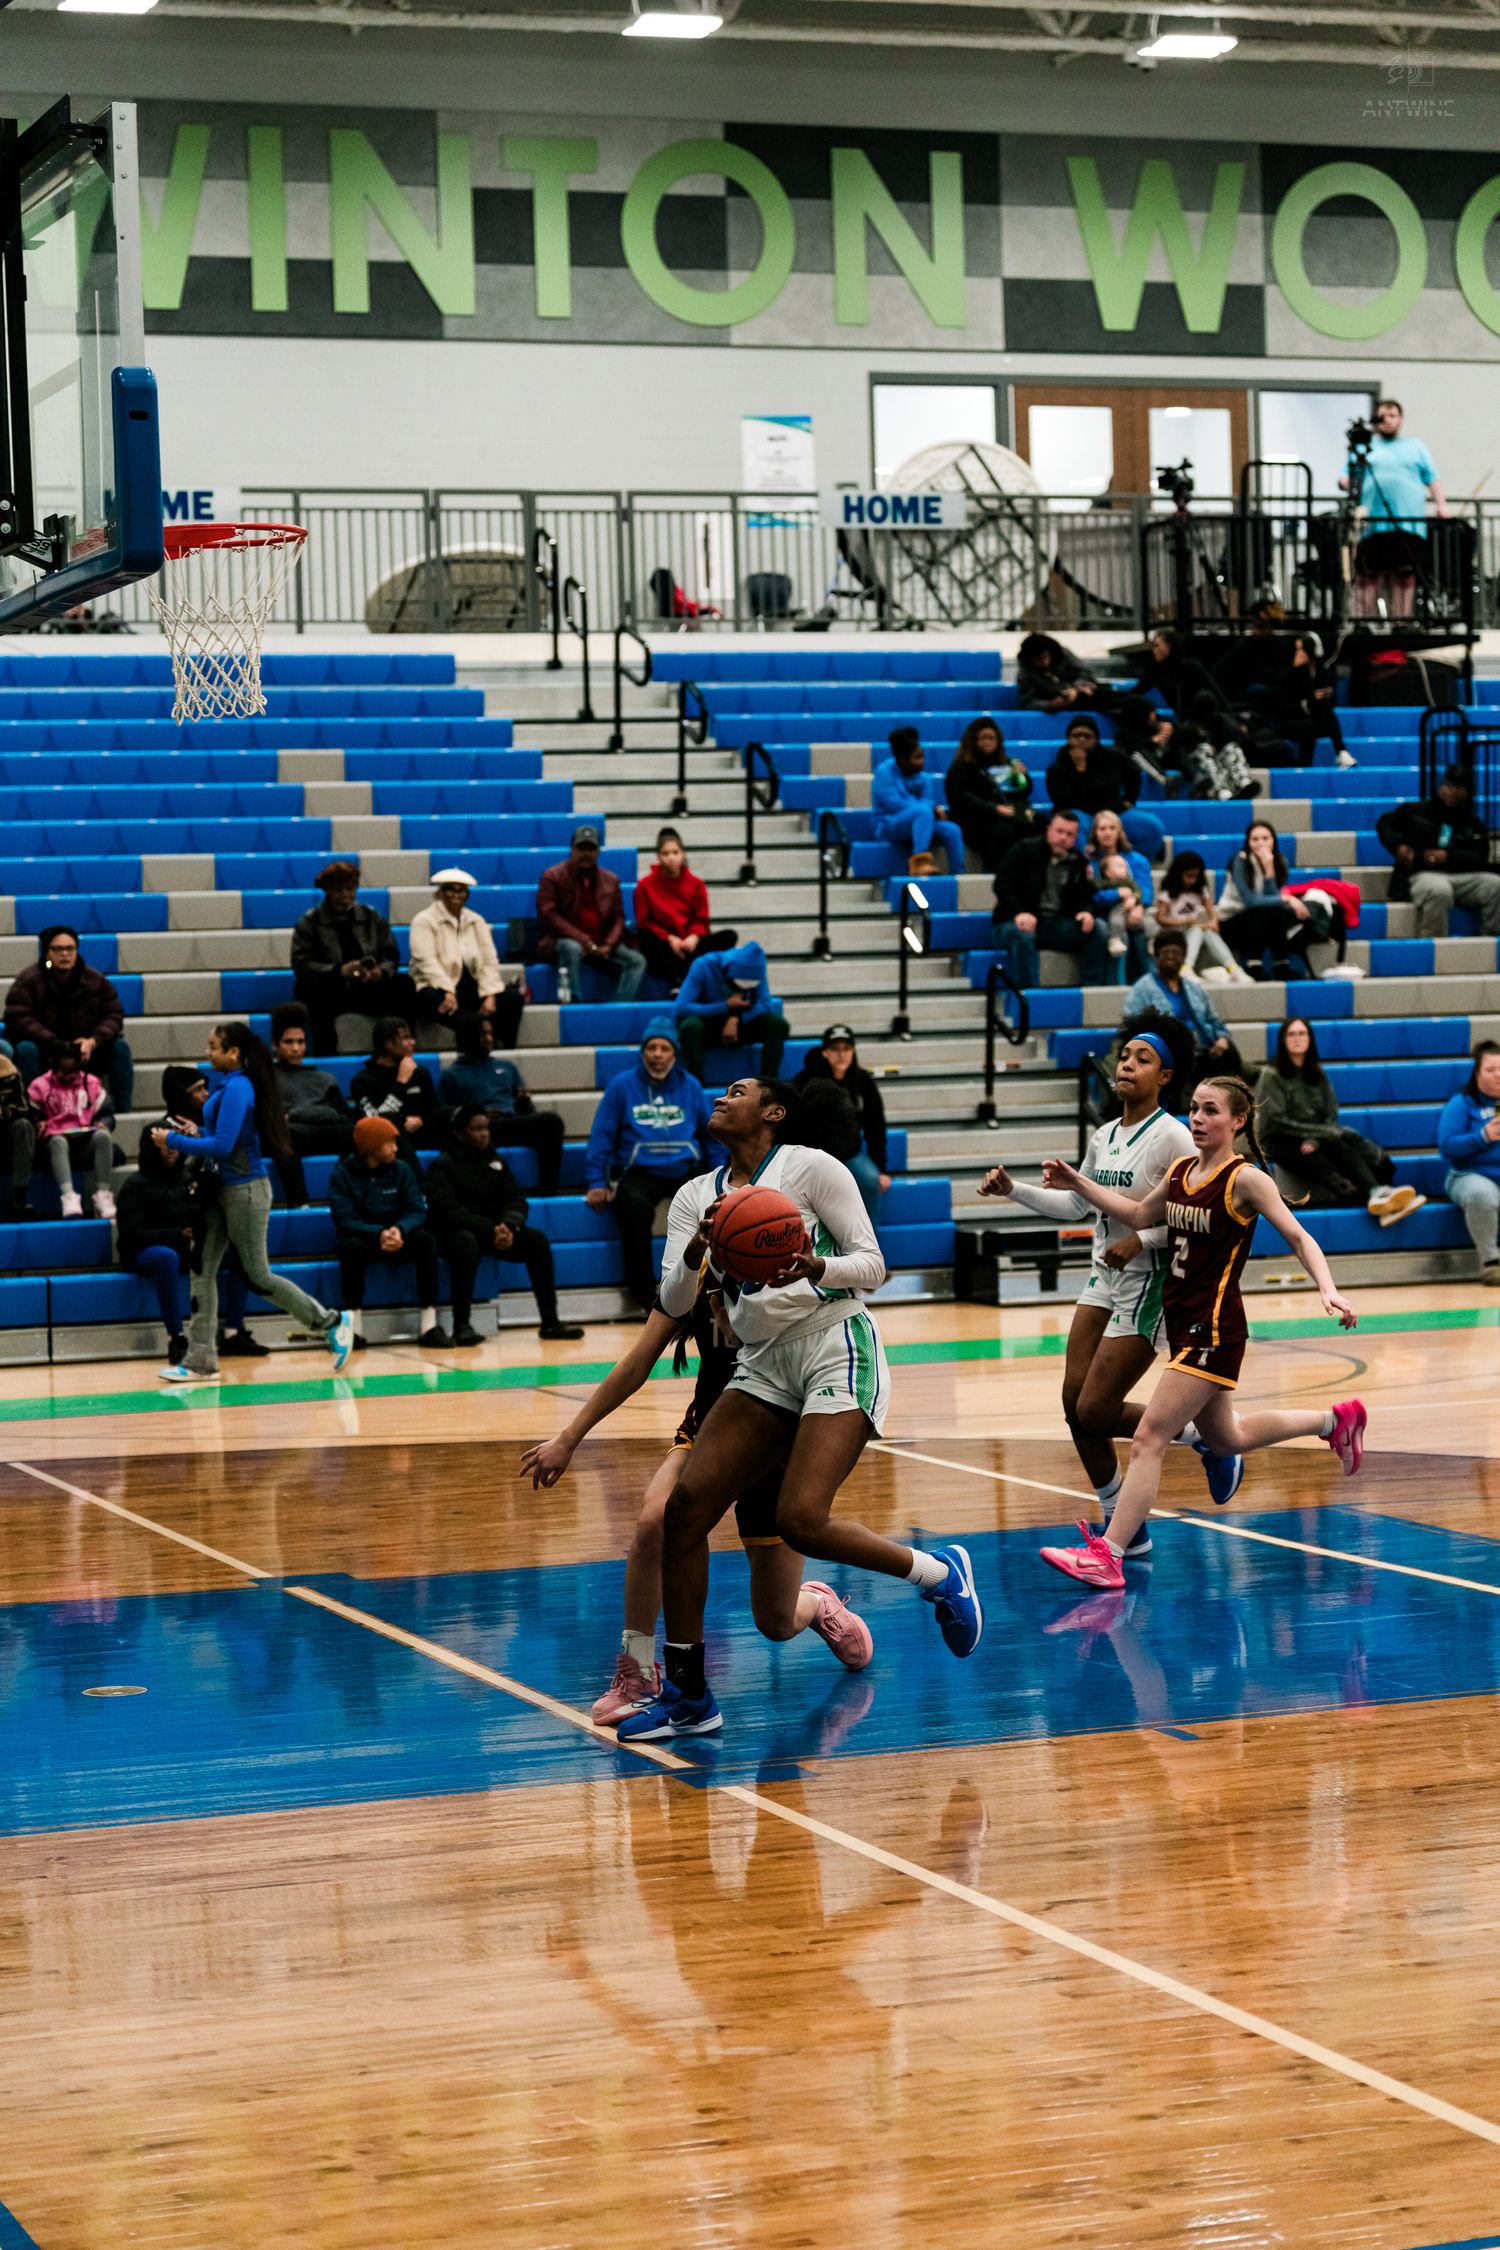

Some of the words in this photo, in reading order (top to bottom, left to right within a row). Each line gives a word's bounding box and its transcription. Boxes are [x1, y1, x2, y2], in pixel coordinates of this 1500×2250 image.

[20, 118, 966, 327] WINTON
[1065, 155, 1500, 342] WO
[843, 495, 943, 525] HOME
[1170, 1235, 1190, 1280] 2
